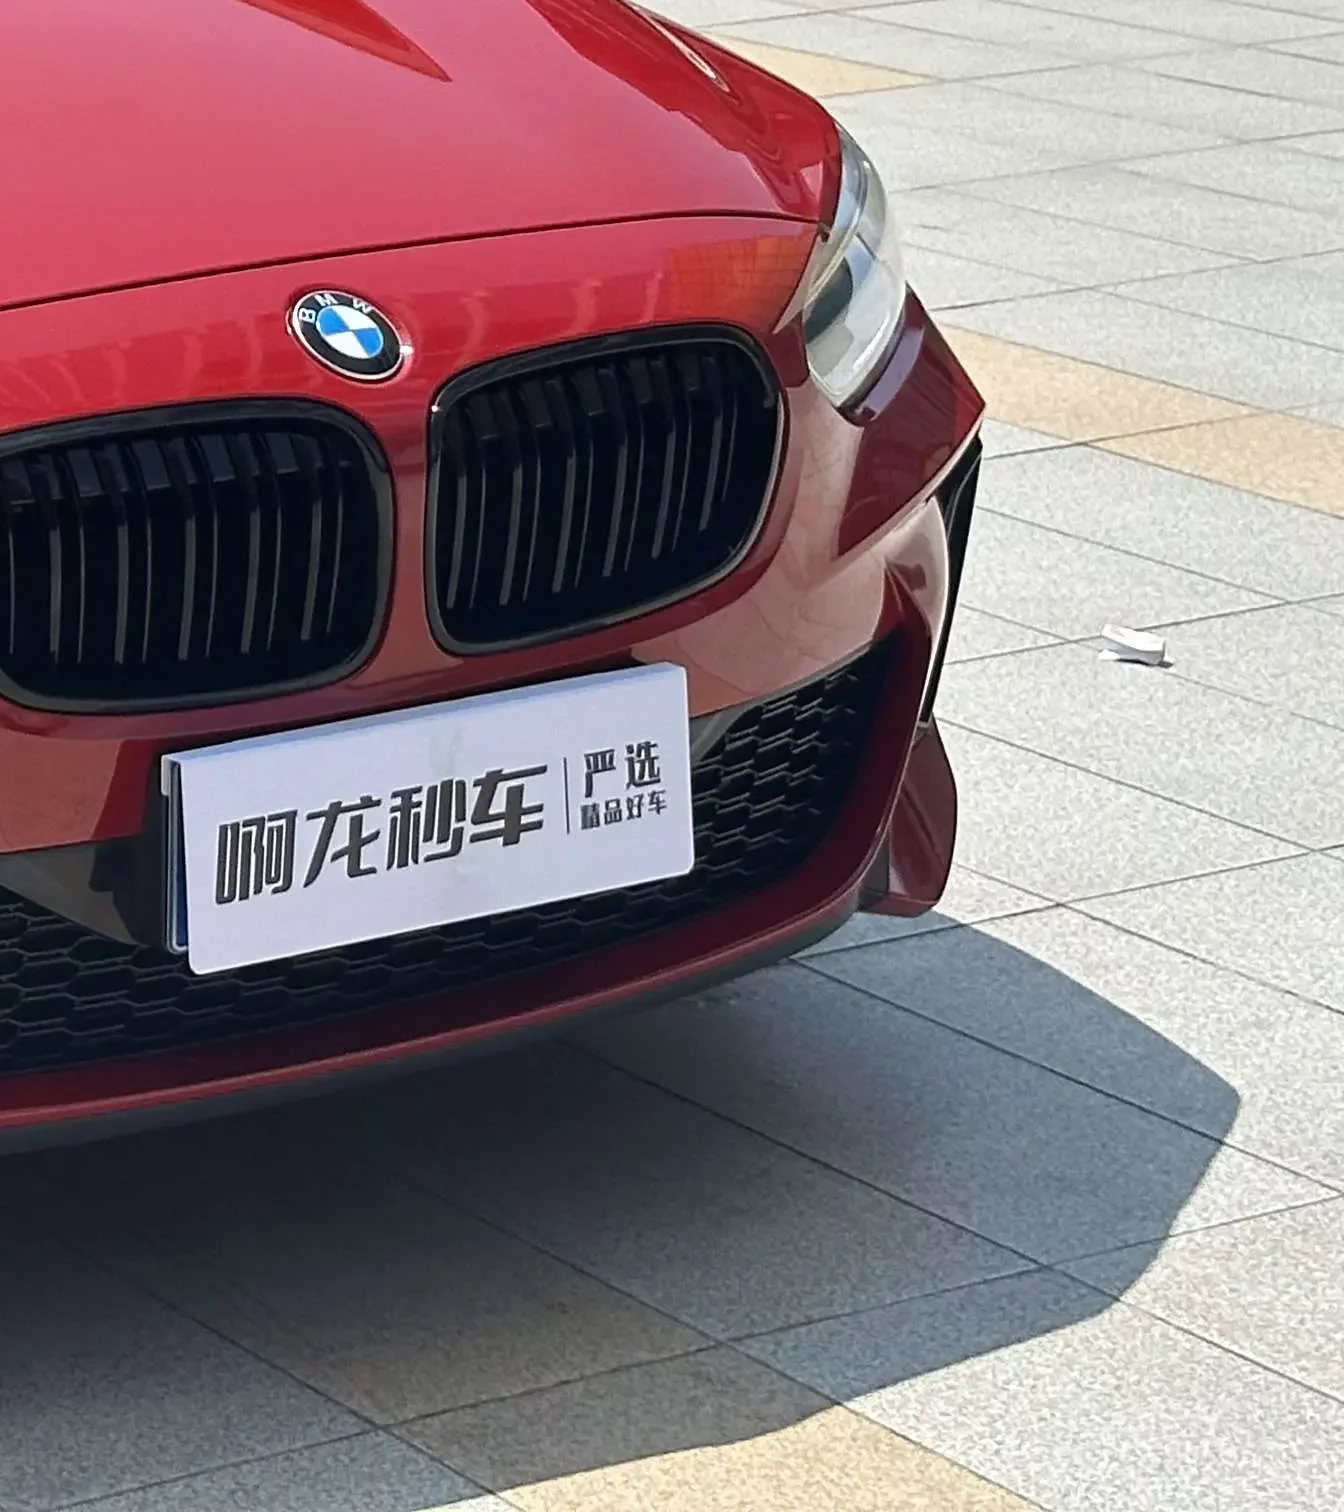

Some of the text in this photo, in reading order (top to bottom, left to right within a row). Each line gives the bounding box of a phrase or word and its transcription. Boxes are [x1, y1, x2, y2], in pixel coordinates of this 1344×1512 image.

[298, 292, 375, 324] BMW
[583, 740, 661, 798] 严选
[580, 789, 667, 830] 精品好车
[215, 764, 548, 905] 啊龙秒车
